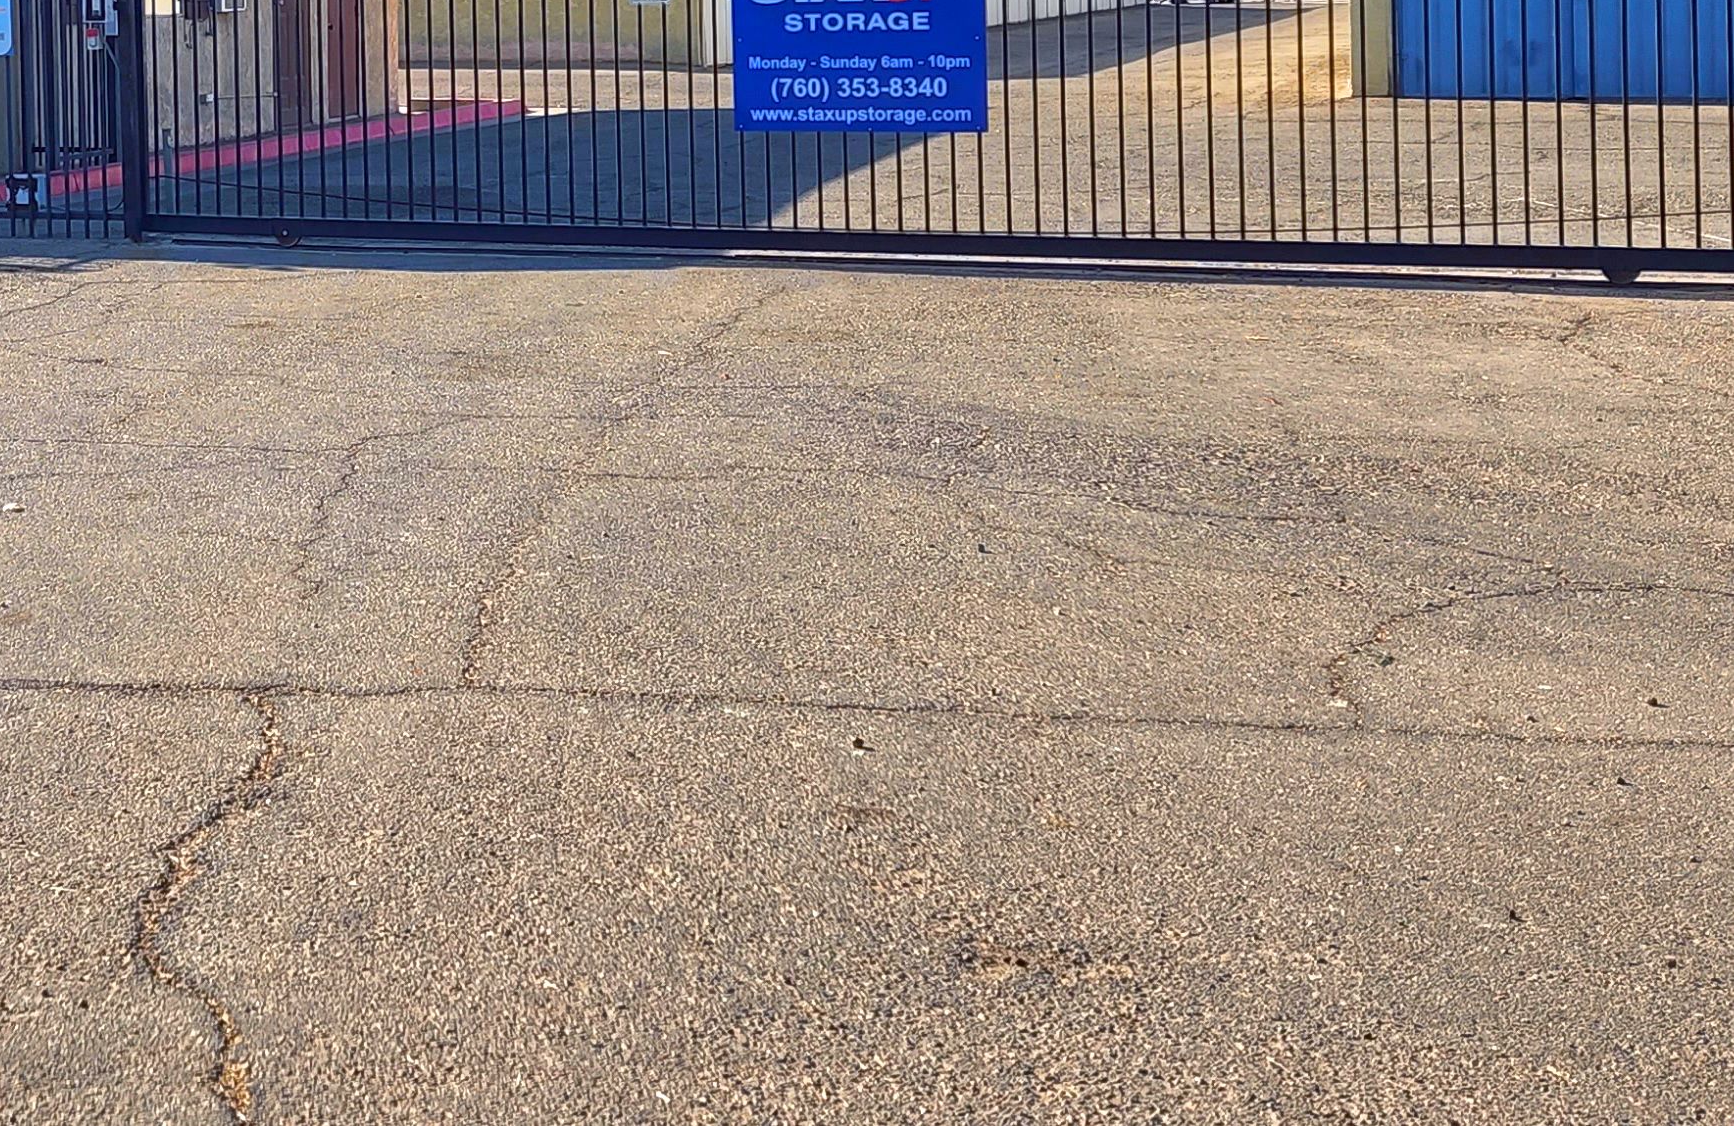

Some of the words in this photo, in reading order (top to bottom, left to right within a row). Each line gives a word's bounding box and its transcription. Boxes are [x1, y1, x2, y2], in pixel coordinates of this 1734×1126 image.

[784, 12, 930, 32] STORAGE
[748, 56, 806, 72] Monday
[820, 55, 877, 71] Sunday
[881, 55, 913, 69] 6am
[928, 55, 971, 70] 10pm
[771, 77, 829, 102] (760)
[837, 77, 947, 97] 353-8340
[750, 107, 972, 125] www.staxupstorage.com
